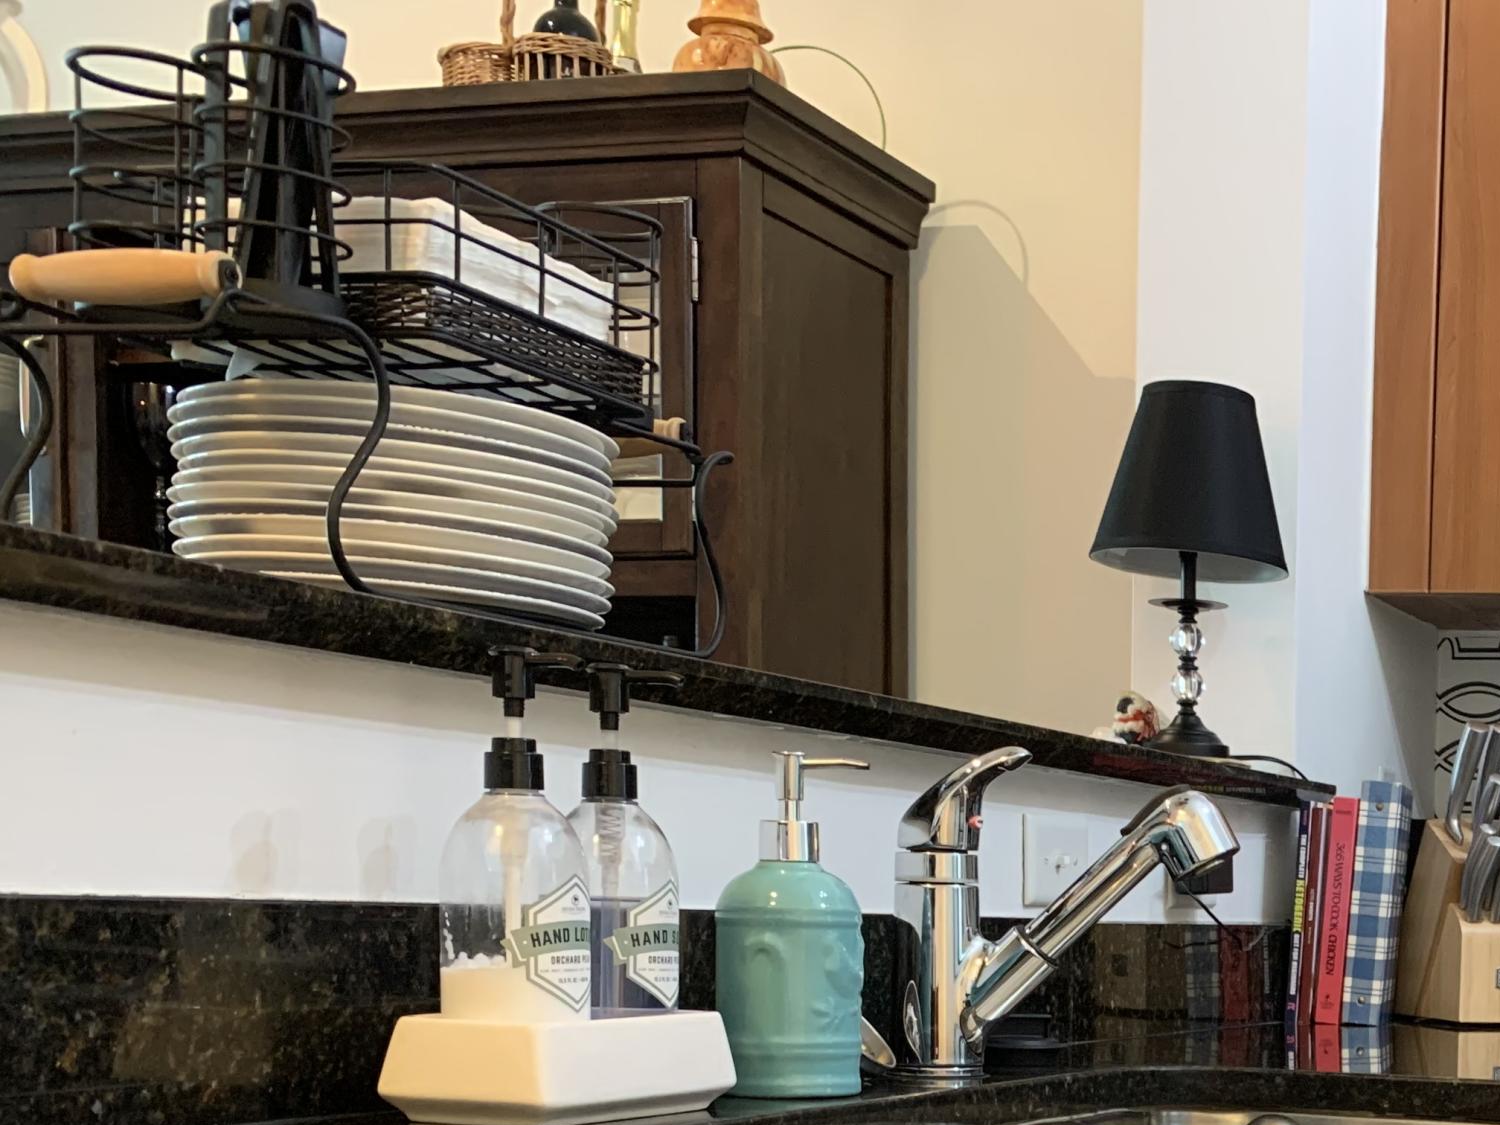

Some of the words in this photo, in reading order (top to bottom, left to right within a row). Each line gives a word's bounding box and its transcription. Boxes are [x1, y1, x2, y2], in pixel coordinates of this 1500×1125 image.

[1293, 879, 1304, 932] KETOGENIC
[530, 927, 570, 948] HAND
[631, 930, 668, 948] HAND
[1325, 934, 1338, 976] CHICKEN
